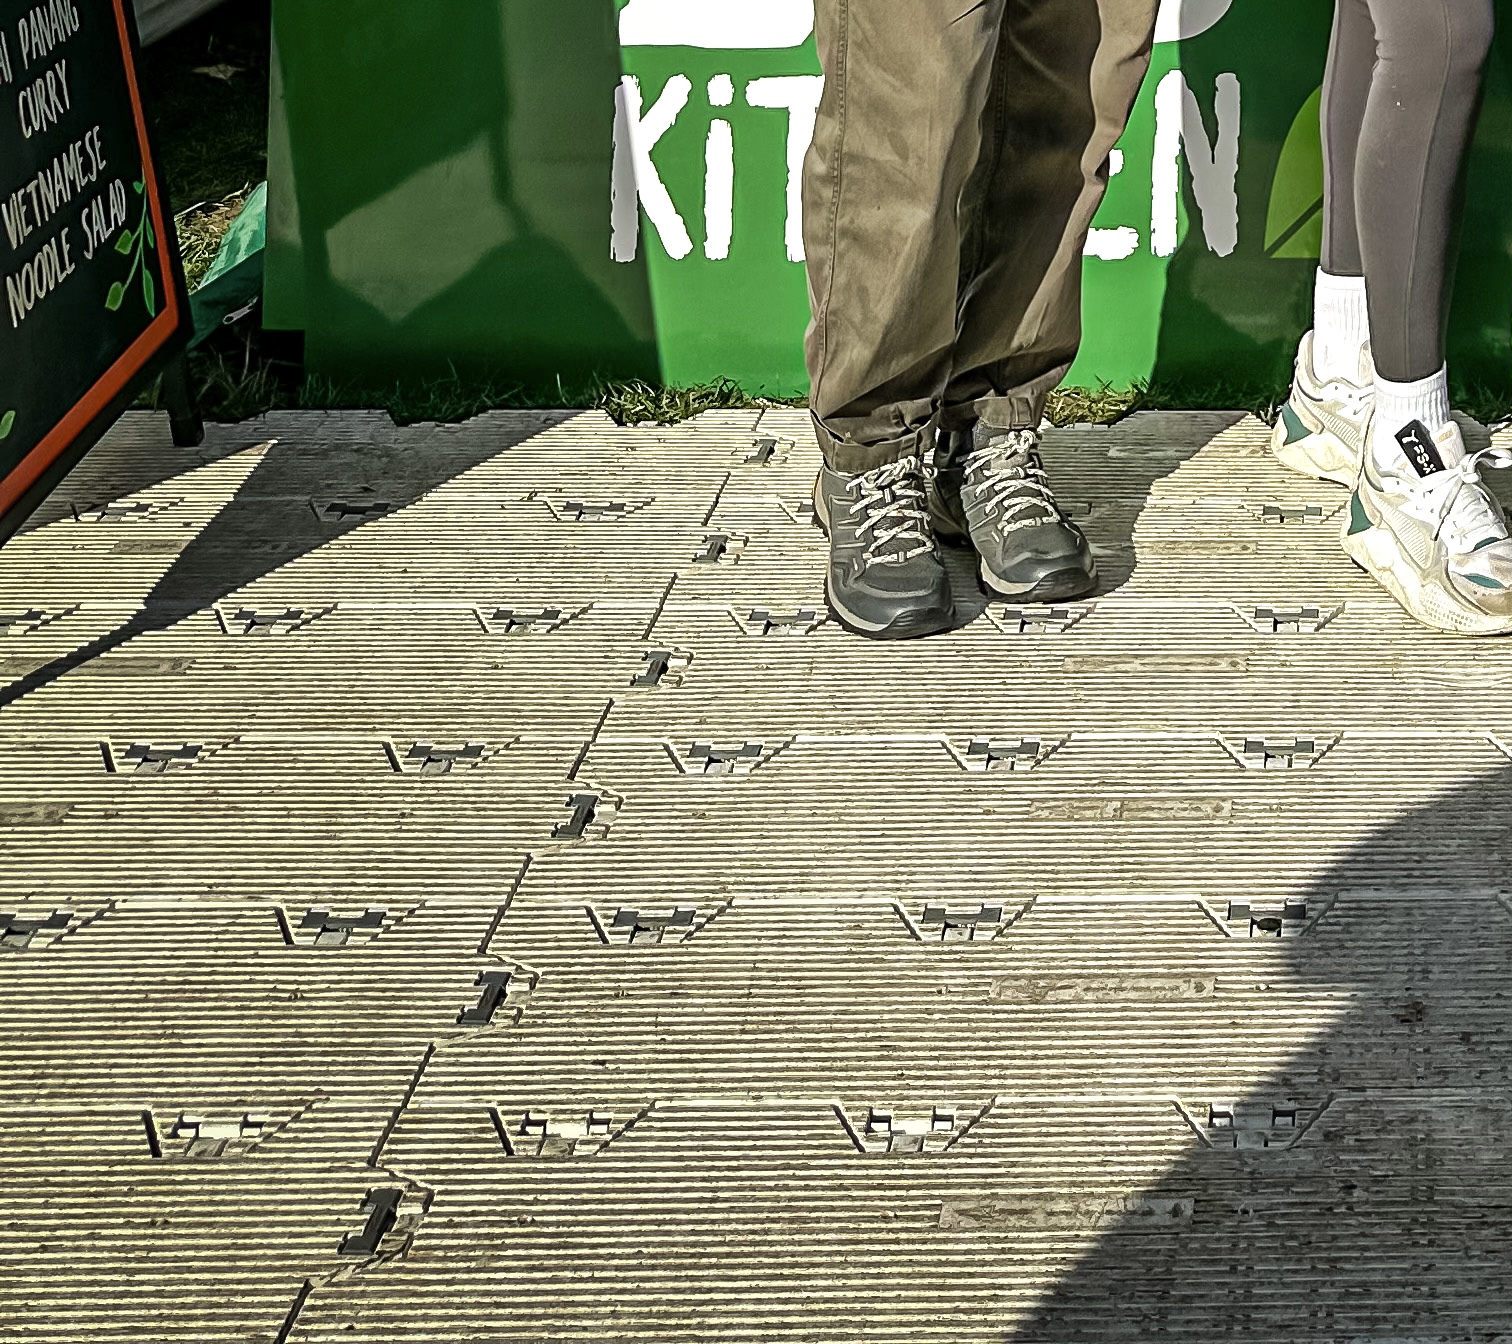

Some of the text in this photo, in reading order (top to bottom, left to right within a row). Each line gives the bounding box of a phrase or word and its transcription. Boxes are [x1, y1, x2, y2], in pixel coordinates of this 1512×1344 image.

[18, 58, 71, 139] CURRY
[1, 126, 107, 251] VIETNAMESE
[5, 178, 127, 328] NOODLE SALAD
